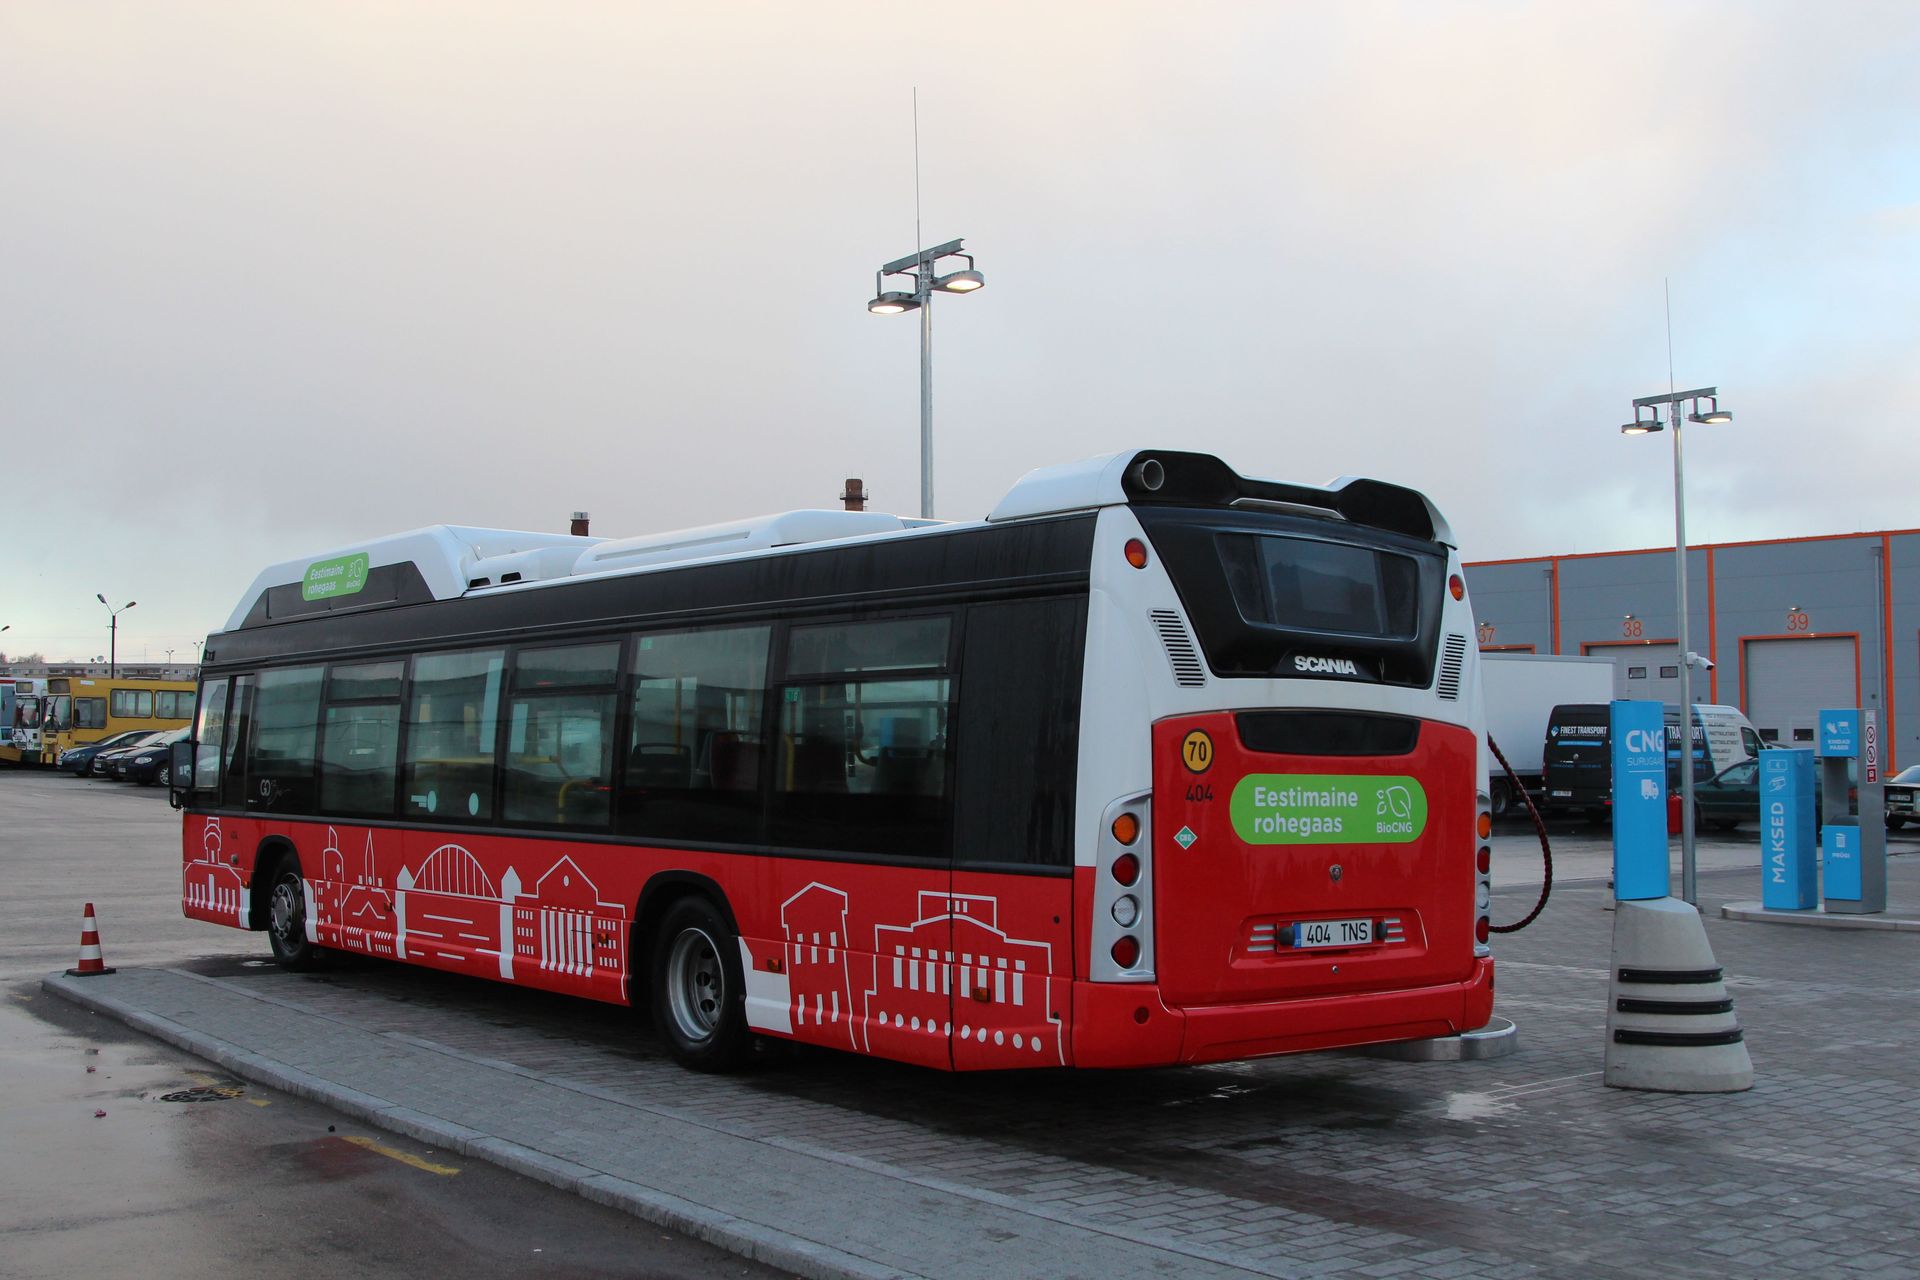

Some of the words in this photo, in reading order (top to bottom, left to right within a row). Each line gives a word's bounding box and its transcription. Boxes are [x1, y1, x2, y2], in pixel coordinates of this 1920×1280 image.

[310, 564, 344, 581] Eestimaine
[307, 581, 337, 595] rohegaas
[1623, 621, 1642, 638] 38
[1786, 613, 1808, 631] 39
[1478, 628, 1496, 644] 37
[1294, 655, 1357, 675] SCANIA
[1560, 726, 1577, 734] FINEST
[1577, 726, 1607, 734] TRANSPORT
[1667, 726, 1703, 740] TRAORT
[1625, 730, 1665, 753] CNG
[1188, 741, 1207, 762] 70
[1185, 784, 1213, 802] 404
[1254, 786, 1359, 807] Eestimaine
[1254, 812, 1343, 837] rohegaas
[1376, 822, 1413, 833] BioCNG
[1771, 802, 1785, 884] MAKSED
[1306, 924, 1331, 944] 404
[1340, 922, 1368, 941] TNS
